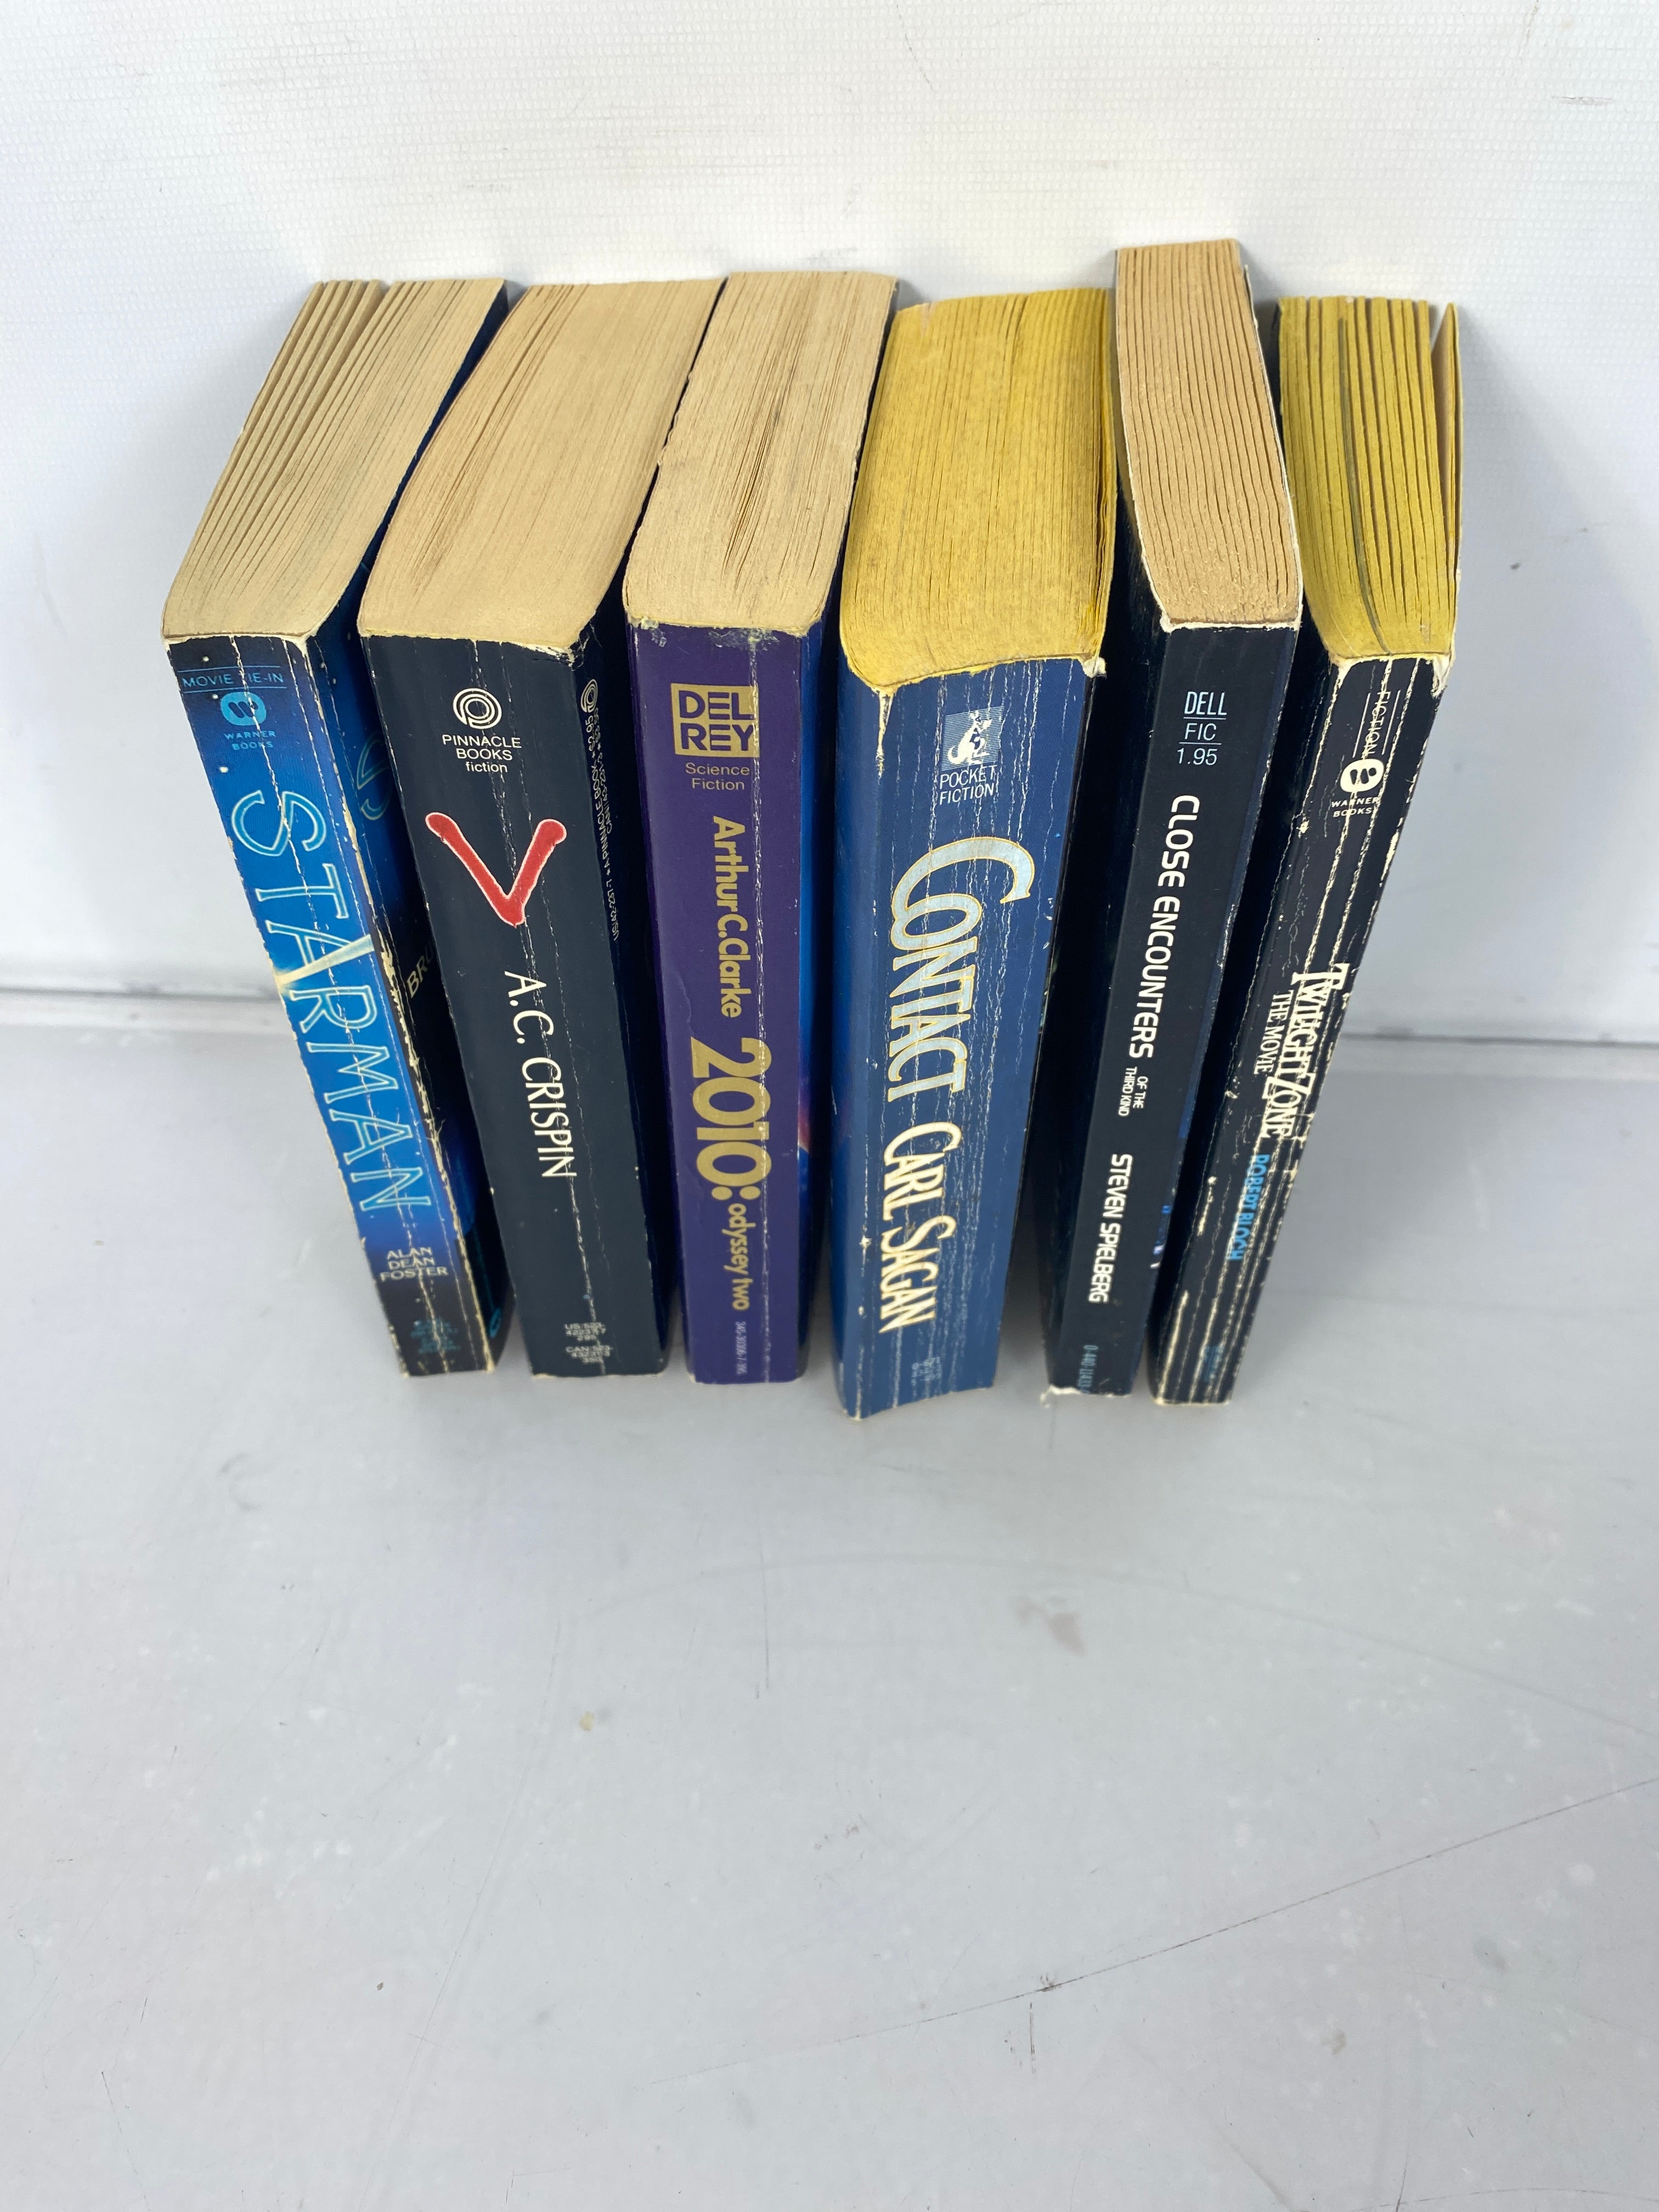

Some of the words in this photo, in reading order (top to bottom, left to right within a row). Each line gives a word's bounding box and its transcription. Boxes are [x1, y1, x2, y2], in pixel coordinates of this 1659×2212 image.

[182, 674, 234, 687] MOVIE
[239, 672, 284, 684] IE-IN
[679, 690, 755, 721] DEL
[1184, 692, 1227, 715] DELL
[224, 731, 276, 740] WARNER
[680, 724, 754, 752] REY
[1184, 723, 1217, 741] FIC
[1364, 691, 1391, 754] FICTION
[232, 741, 273, 750] BOOKS
[442, 734, 522, 749] PINNACLE
[455, 748, 513, 761] BOOKS
[1177, 747, 1218, 766] 1.95
[466, 761, 507, 772] fiction
[591, 759, 601, 799] BOOK
[685, 762, 750, 776] Science
[939, 764, 996, 789] POCKET
[691, 777, 745, 791] Fiction
[939, 783, 995, 805] FICTION
[1333, 808, 1372, 817] BOOKS
[595, 798, 609, 860] PINNACLE
[1158, 795, 1200, 888] CLOSE
[425, 812, 567, 928] V
[714, 816, 749, 912] Arthur
[719, 937, 752, 1018] Clarke
[888, 836, 1035, 1103] CONTACT
[1129, 895, 1181, 1059] ENCOUNTERS
[231, 790, 432, 1211] STARMAN
[1268, 989, 1294, 1023] THE
[1275, 963, 1350, 1079] TWILIGHT
[1254, 1024, 1286, 1075] MOVIE
[1122, 1066, 1137, 1094] THIRD
[1137, 1076, 1148, 1090] OF
[1118, 1094, 1132, 1116] KIND
[1133, 1091, 1146, 1109] THE
[1261, 1073, 1316, 1139] ZONE
[522, 1056, 578, 1179] CRISPIN
[691, 1036, 772, 1200] 2010:
[883, 1121, 962, 1221] CARL
[1102, 1154, 1133, 1220] STEVEN
[387, 1246, 433, 1260] ALAN
[722, 1203, 756, 1276] odyssey
[380, 1266, 449, 1282] FOSTER
[387, 1257, 435, 1270] DEAN
[879, 1215, 957, 1334] SAGAN
[1088, 1222, 1122, 1304] SPIELBERG
[732, 1274, 752, 1311] two
